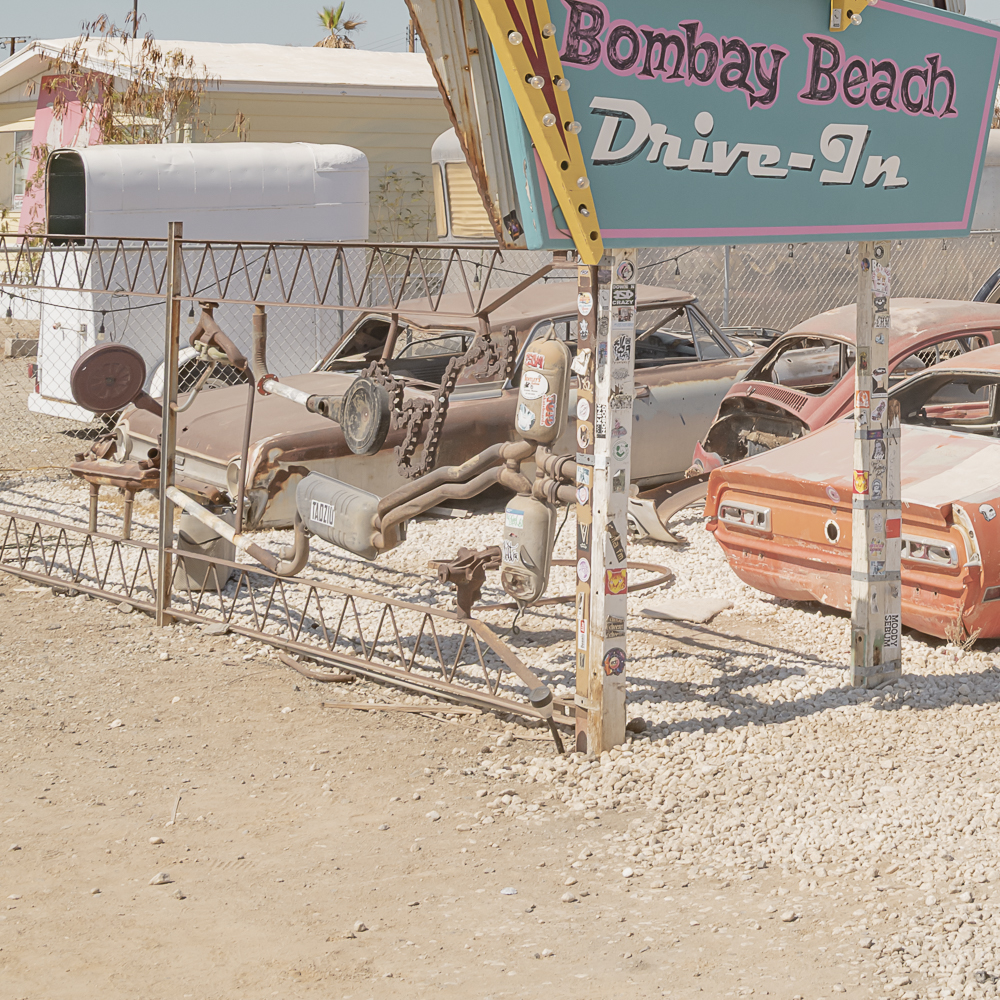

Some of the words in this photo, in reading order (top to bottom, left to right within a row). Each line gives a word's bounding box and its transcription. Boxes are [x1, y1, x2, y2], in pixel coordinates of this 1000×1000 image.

[800, 34, 958, 118] Beach
[589, 96, 909, 189] Drive-In
[884, 614, 892, 647] SEBUM
[891, 614, 899, 647] MOODY
